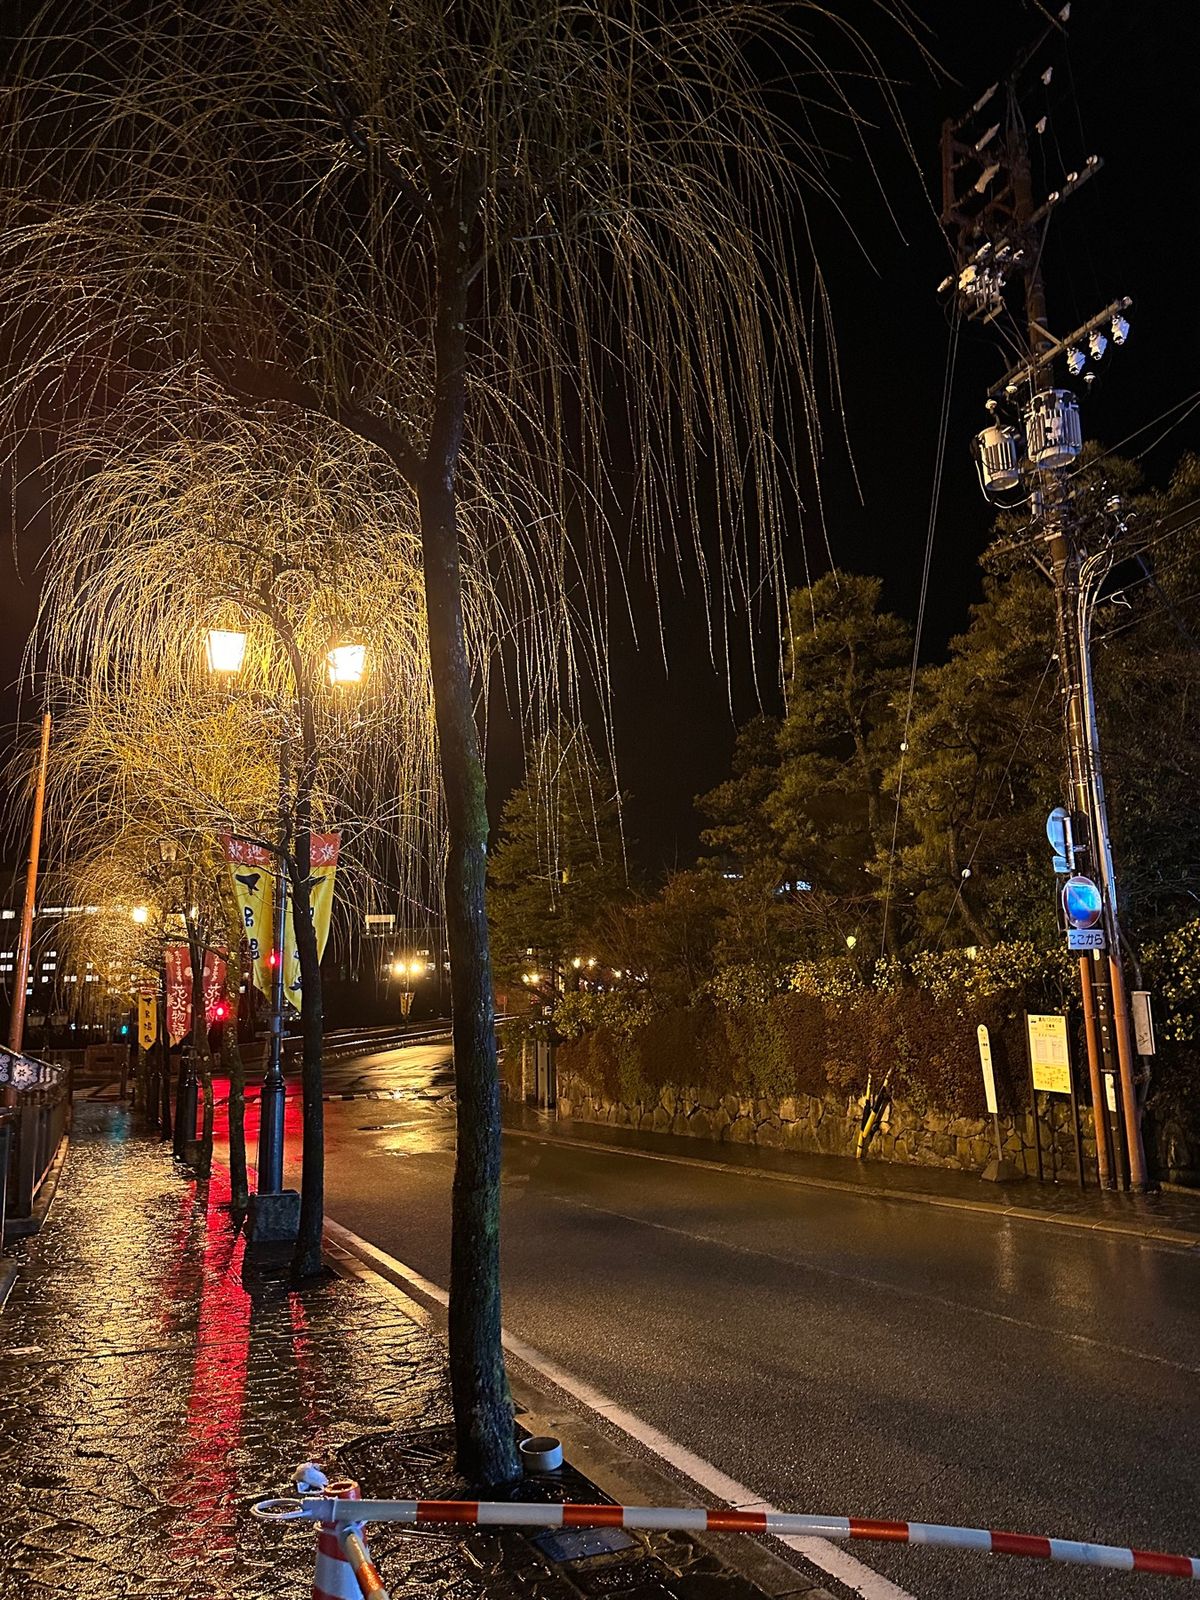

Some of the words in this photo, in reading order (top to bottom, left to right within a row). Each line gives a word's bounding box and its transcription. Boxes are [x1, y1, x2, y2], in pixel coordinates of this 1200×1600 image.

[1069, 934, 1102, 945] ここから
[171, 983, 187, 1036] 花火物語
